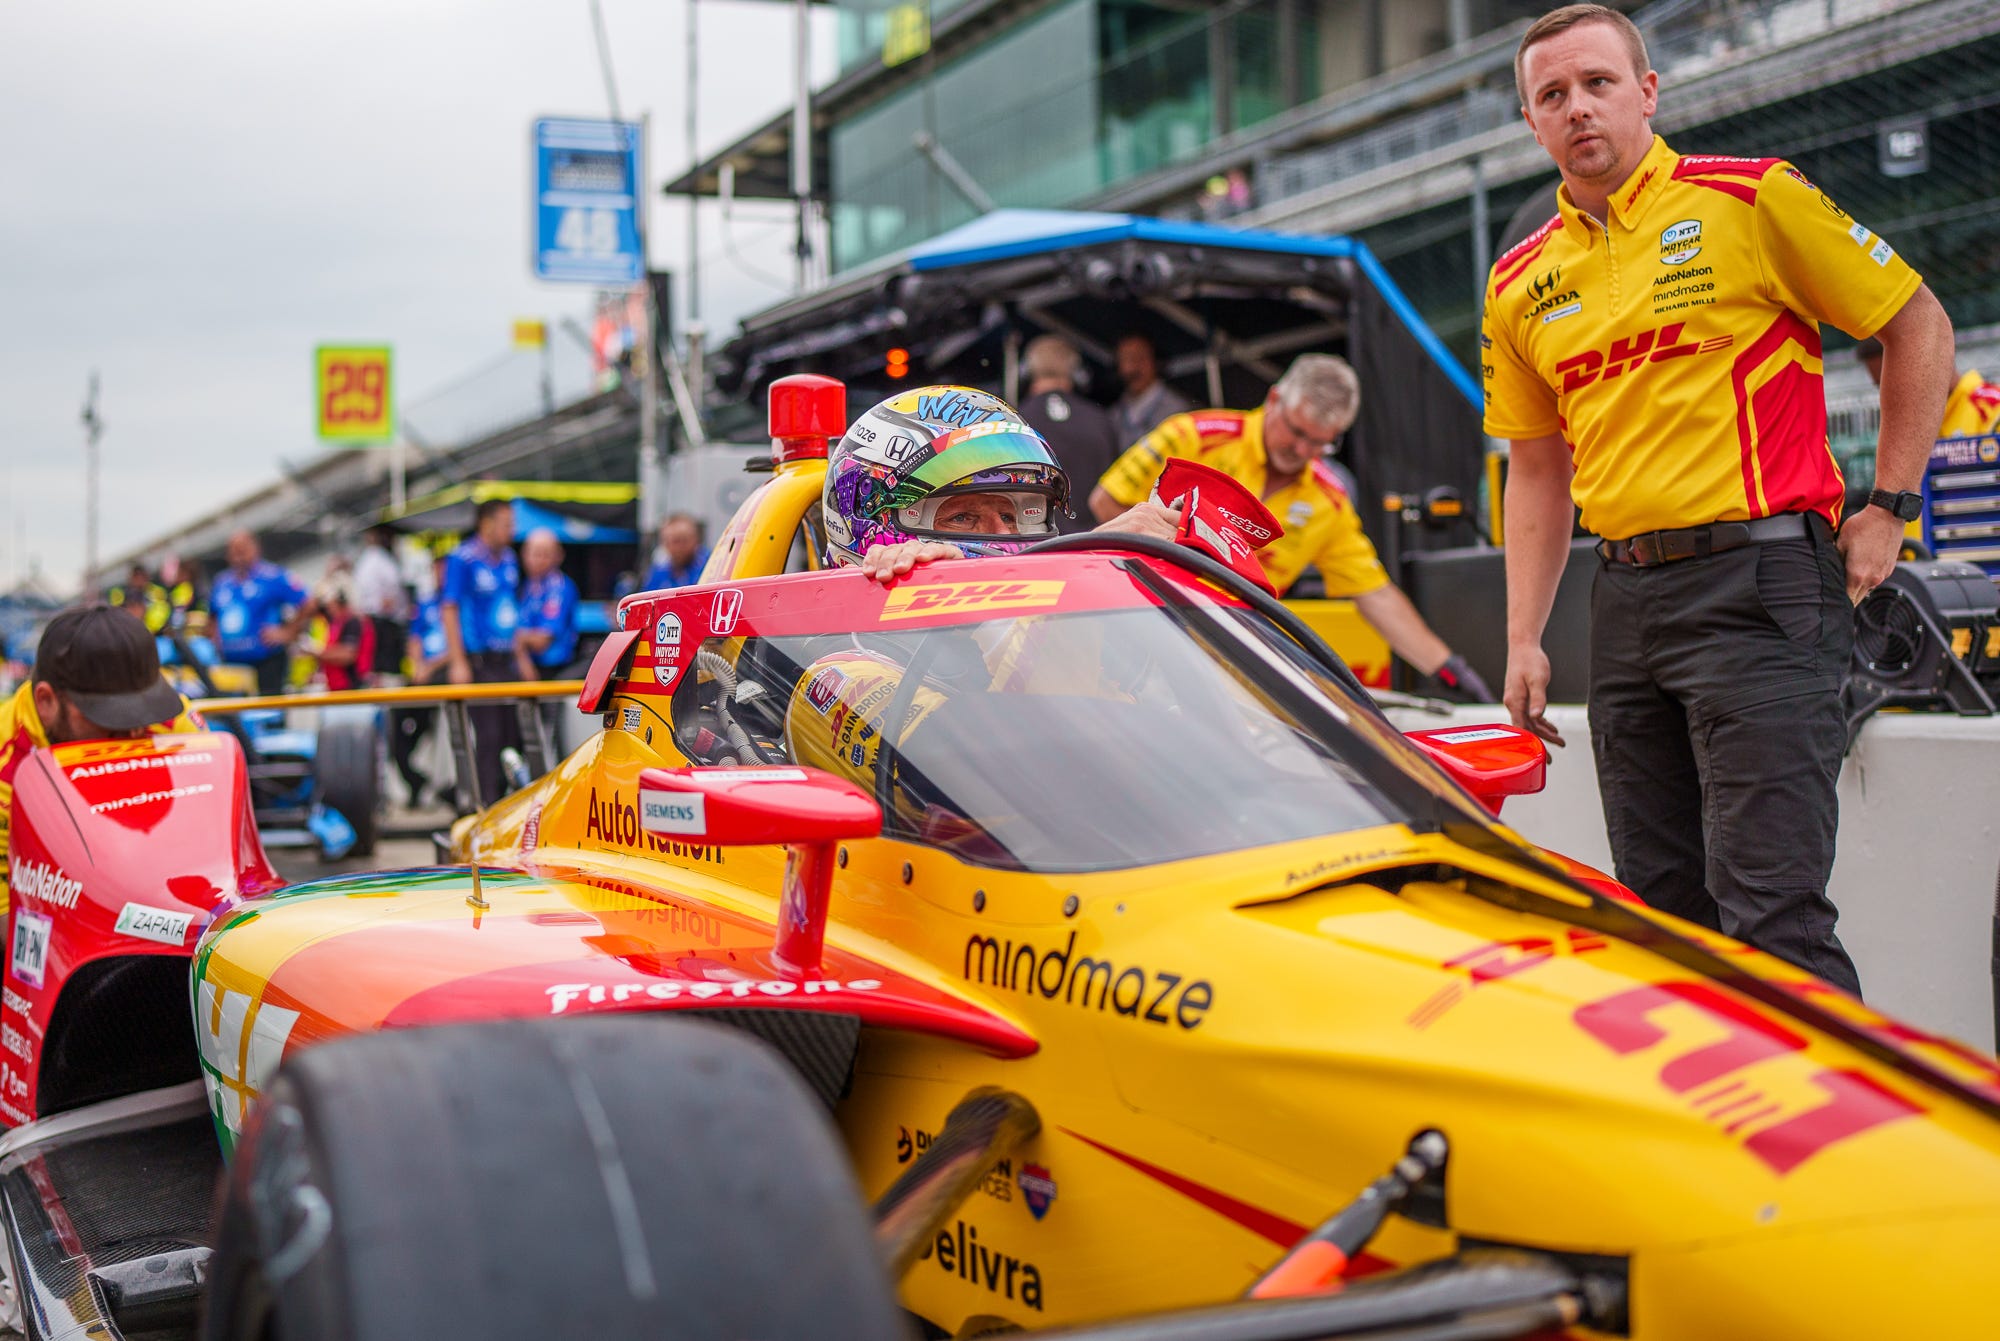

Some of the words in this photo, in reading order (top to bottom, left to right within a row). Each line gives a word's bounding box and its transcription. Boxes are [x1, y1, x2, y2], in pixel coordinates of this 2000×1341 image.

[1660, 235, 1701, 253] INDYCAR
[1679, 225, 1698, 236] NTT
[1653, 266, 1713, 287] AutoNation
[1653, 282, 1715, 303] mindmaze
[1654, 302, 1689, 314] RICHARD
[1691, 297, 1717, 307] MILLE
[1555, 322, 1703, 395] DHL
[324, 360, 387, 425] 29
[896, 447, 929, 475] ANDRETTI
[905, 584, 1032, 611] DHL
[666, 626, 680, 638] NTT
[655, 647, 680, 658] INDYCAR
[842, 682, 897, 744] GAINBRIDGE
[70, 753, 213, 780] AutoNation
[90, 784, 214, 815] mindmaze
[645, 803, 694, 821] SIEMENS
[10, 857, 83, 909] AutoNation
[133, 912, 185, 938] ZAPATA
[964, 930, 1213, 1030] mindmaze
[546, 980, 883, 1014] Firestone
